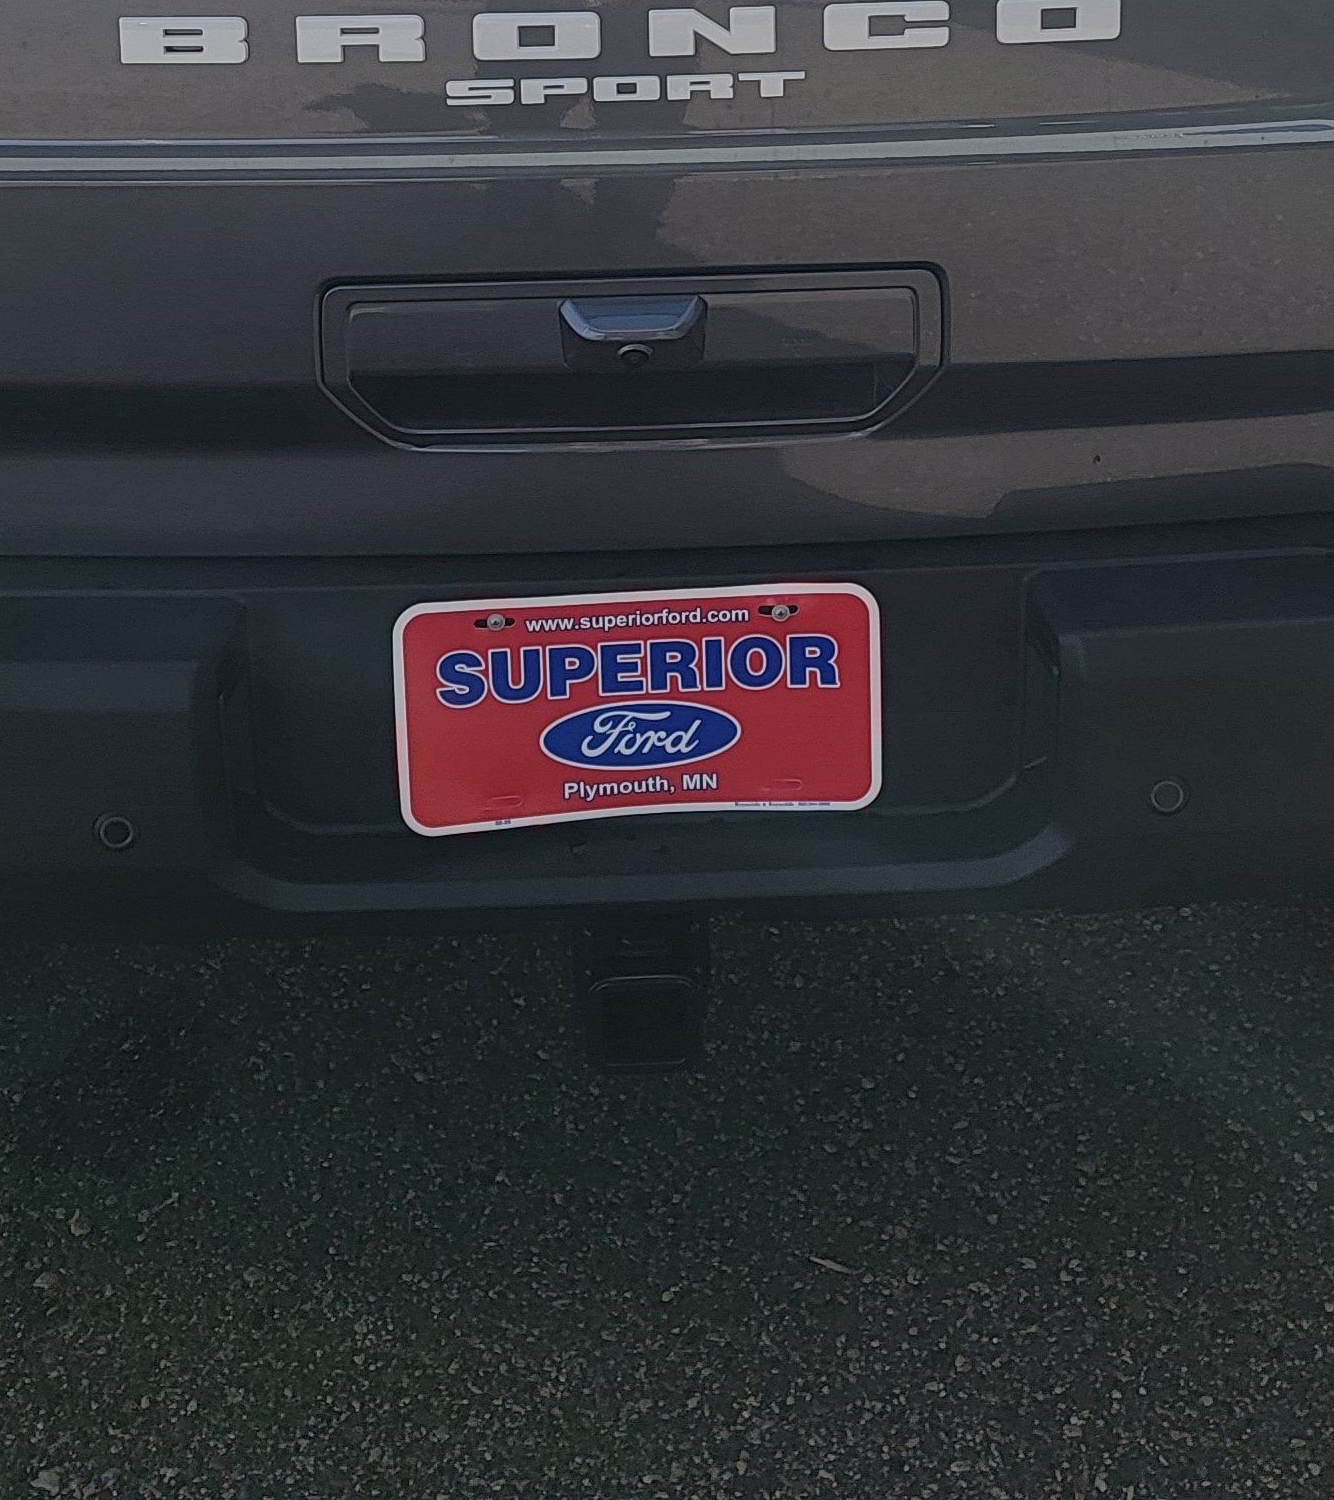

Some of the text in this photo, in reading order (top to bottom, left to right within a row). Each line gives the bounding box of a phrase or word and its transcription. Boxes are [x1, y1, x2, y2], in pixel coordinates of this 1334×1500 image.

[445, 70, 806, 107] SPORT
[525, 606, 749, 633] www.superiorford.com
[435, 633, 839, 709] SUPERIOR
[581, 710, 701, 758] Ford
[563, 773, 718, 802] Plymouth, MN
